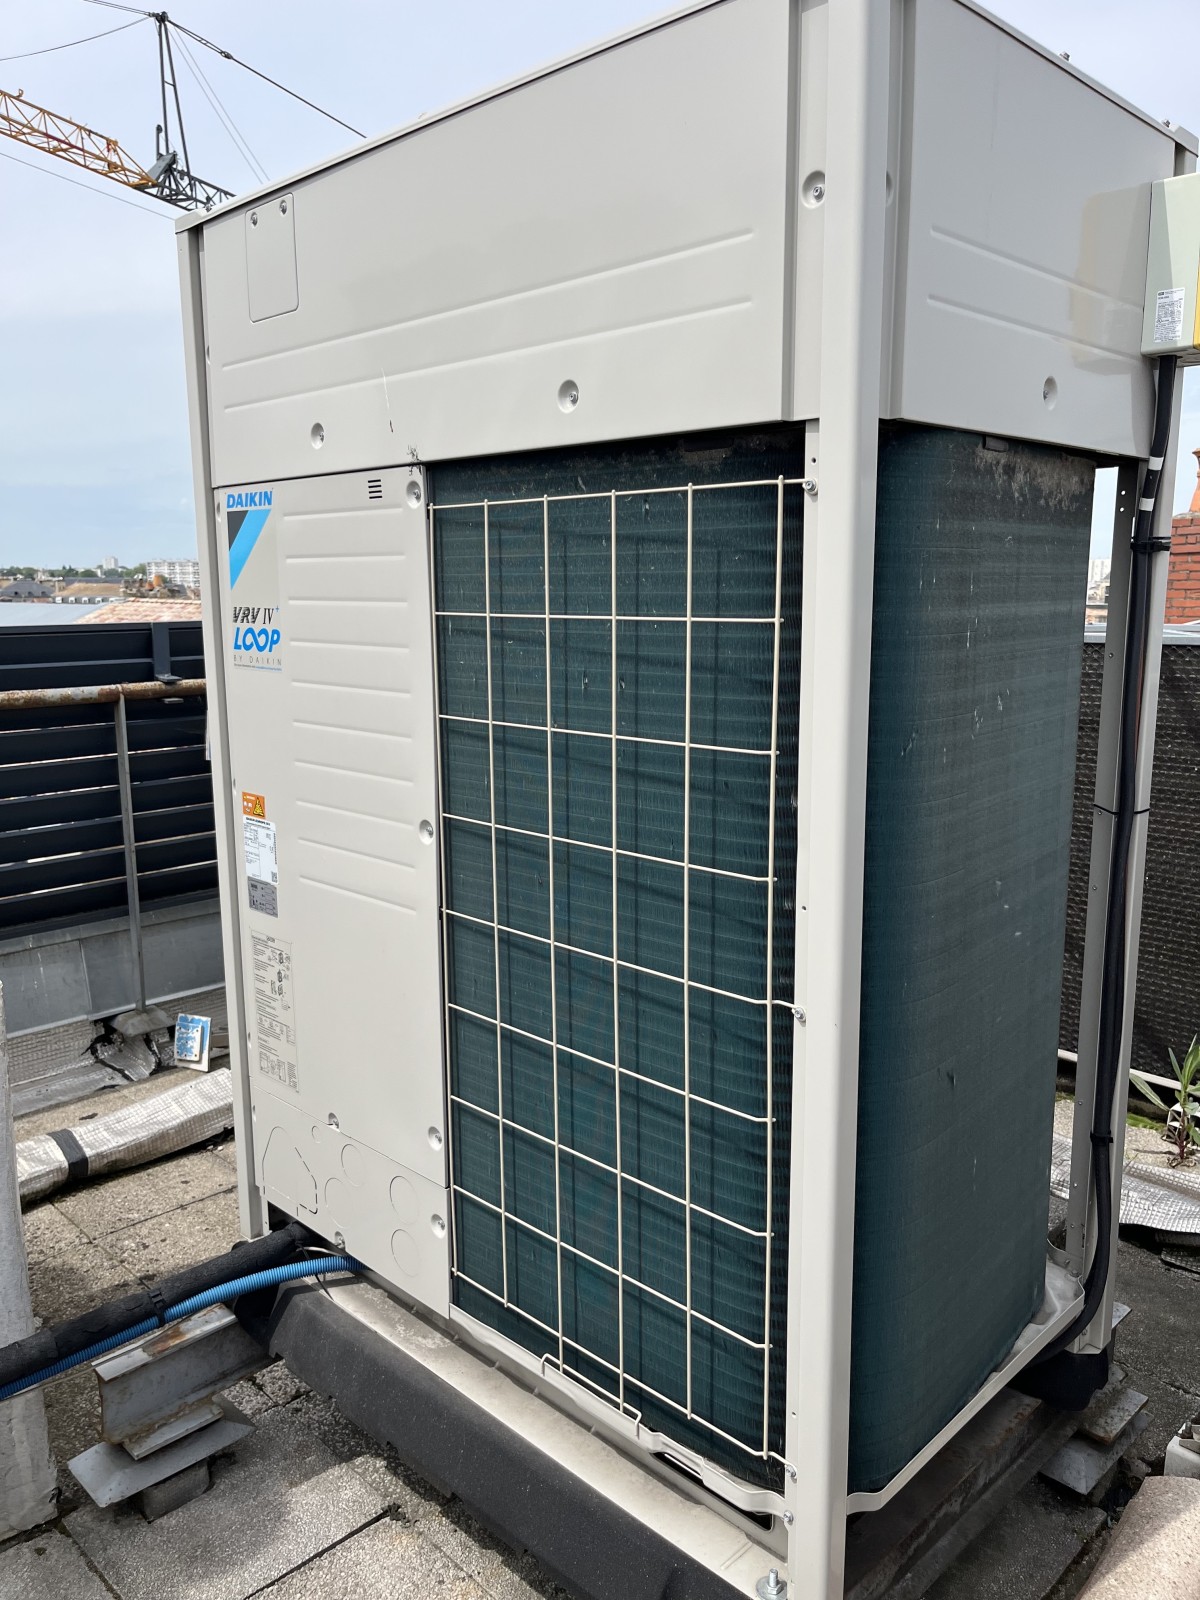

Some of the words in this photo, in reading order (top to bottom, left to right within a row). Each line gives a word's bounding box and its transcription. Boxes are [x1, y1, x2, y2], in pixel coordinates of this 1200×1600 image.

[227, 490, 272, 508] DAIKIN
[232, 606, 261, 624] VRV
[233, 626, 280, 652] LOOP
[234, 654, 242, 662] BY
[249, 655, 282, 666] DAIKIN
